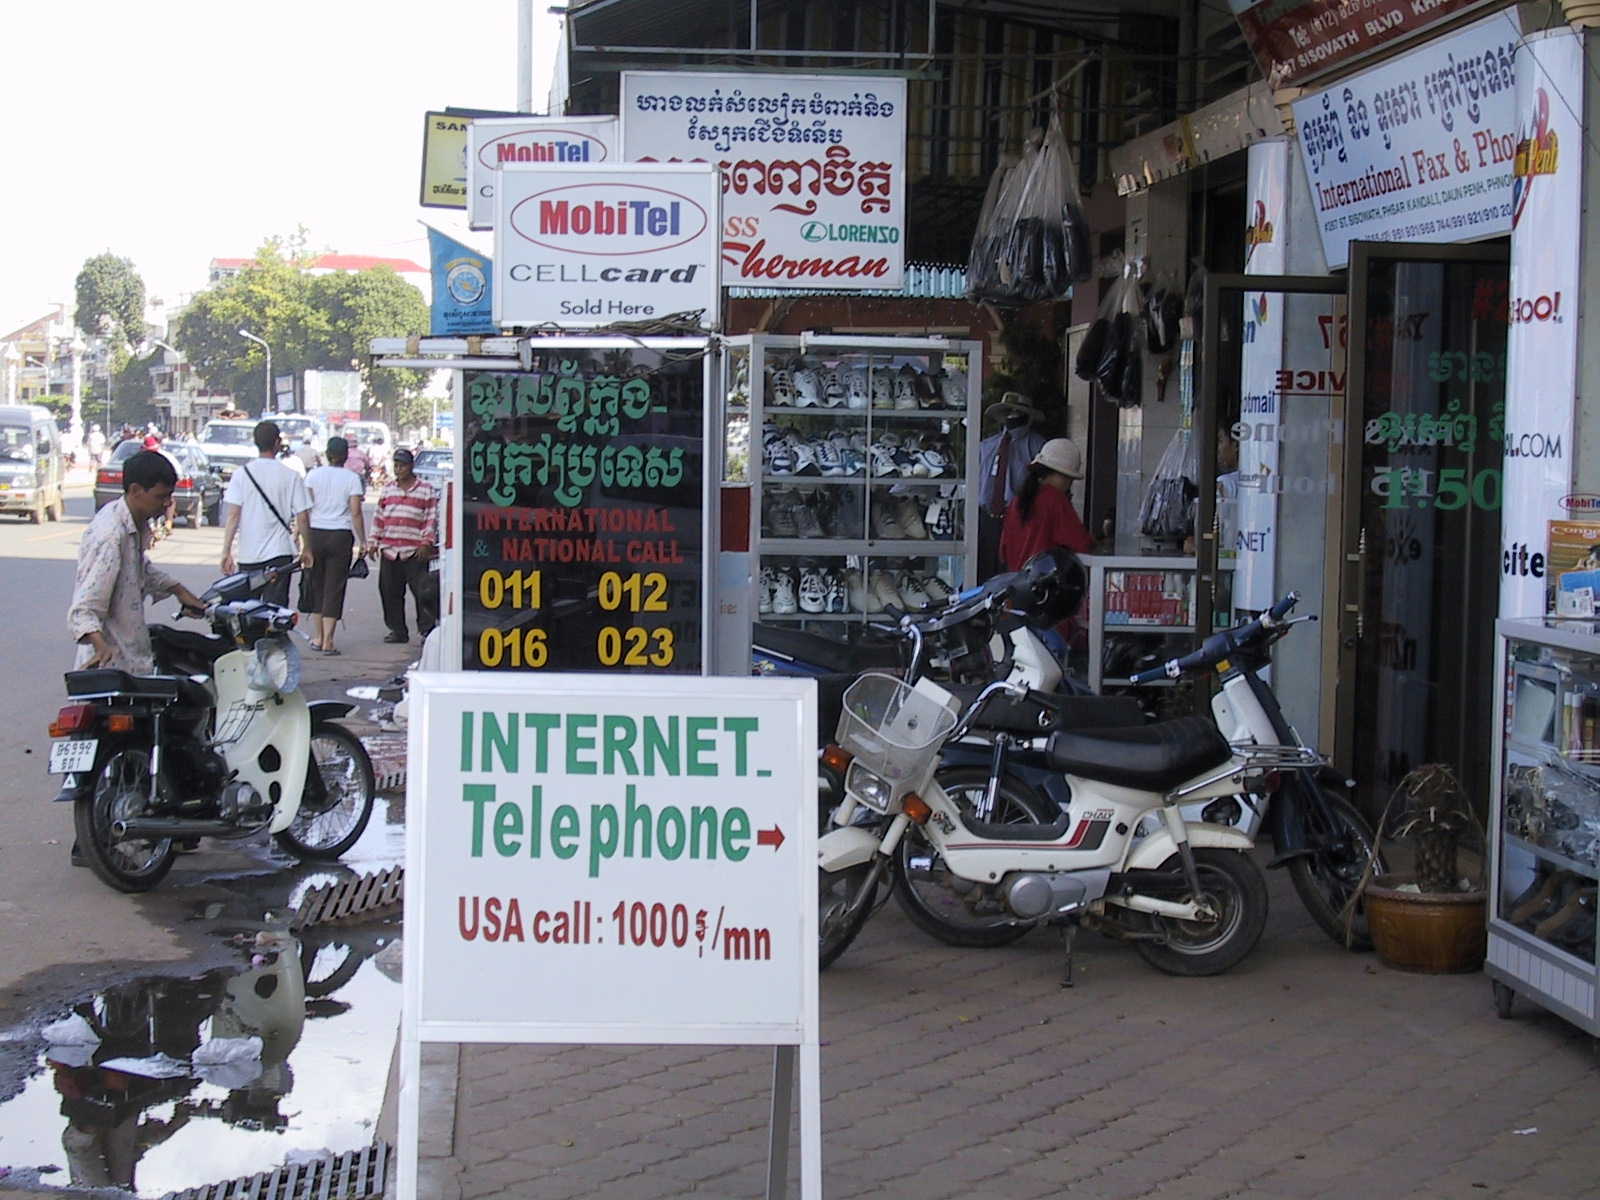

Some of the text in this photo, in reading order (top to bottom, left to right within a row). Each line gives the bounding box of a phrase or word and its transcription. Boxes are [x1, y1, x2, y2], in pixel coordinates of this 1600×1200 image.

[1299, 30, 1360, 68] SISOVATH
[1364, 8, 1404, 38] BLVD
[496, 140, 590, 163] MobiTel
[1314, 154, 1413, 212] International
[1412, 149, 1450, 185] Fax
[1453, 137, 1471, 173] &
[539, 200, 680, 236] MobiTel
[509, 264, 698, 284] CELLcard
[560, 300, 655, 316] Sold Here
[476, 506, 676, 533] INTERNATIONAL
[472, 539, 684, 564] & NATIONAL CALL
[479, 568, 542, 610] 011
[598, 571, 669, 613] 012
[479, 626, 674, 668] 016 023
[463, 783, 752, 878] Telephone
[458, 895, 525, 943] USA
